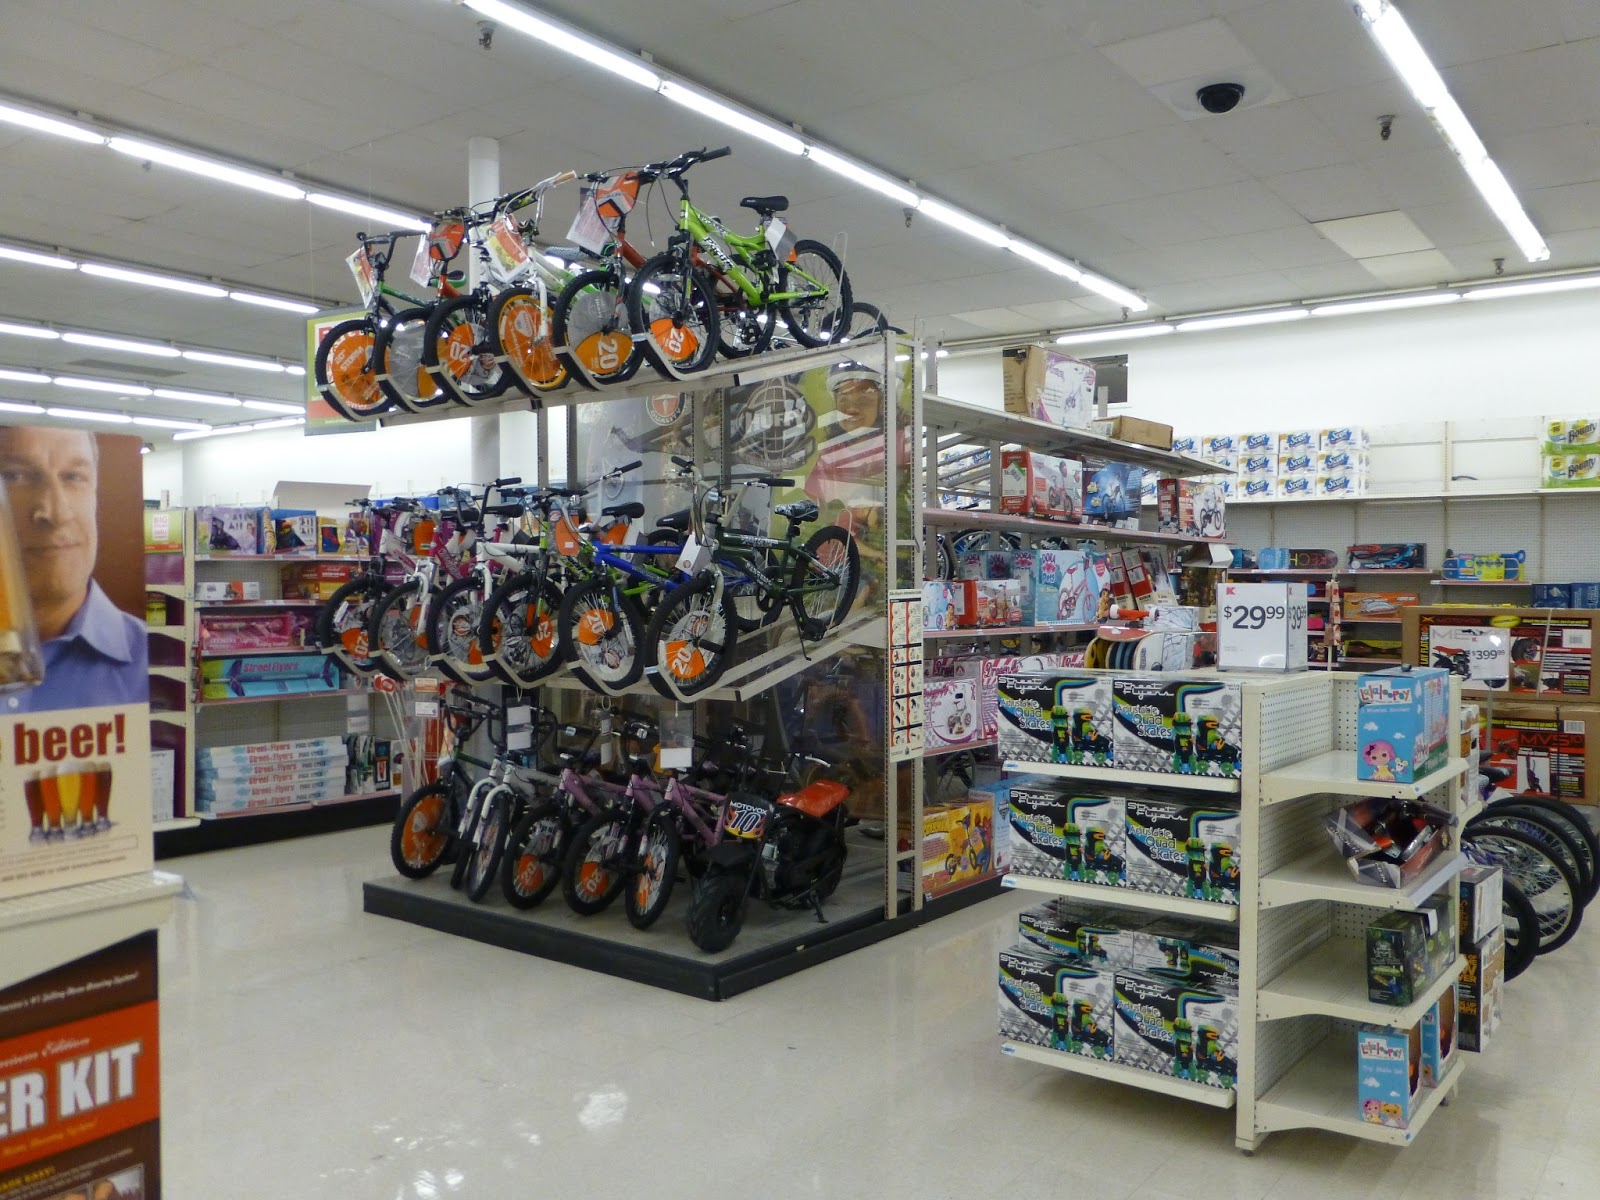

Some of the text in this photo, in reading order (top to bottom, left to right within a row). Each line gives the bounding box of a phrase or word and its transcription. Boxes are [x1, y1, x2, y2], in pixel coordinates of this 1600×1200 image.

[668, 329, 684, 353] 20
[450, 341, 471, 361] 20
[598, 339, 618, 369] 20
[650, 407, 681, 423] QUALITY
[1568, 422, 1597, 443] Bounty
[1568, 458, 1596, 478] Bounty
[587, 612, 604, 634] 20
[672, 647, 691, 675] 20
[998, 677, 1042, 685] Street
[1114, 681, 1162, 690] Street
[1006, 684, 1053, 694] Flyers
[1123, 687, 1174, 700] Flyers
[1014, 708, 1043, 718] Quad
[1132, 714, 1163, 725] Quad
[1019, 718, 1050, 729] Skates
[1137, 724, 1172, 738] Skates
[14, 713, 125, 765] beer!
[1010, 790, 1055, 800] Street
[730, 800, 768, 815] MOTOVOX
[1018, 798, 1065, 809] Flyers
[1127, 802, 1176, 814] Street
[729, 810, 761, 833] 10
[1136, 810, 1188, 822] Flyers
[1026, 822, 1054, 834] Quad
[1031, 832, 1063, 846] Skates
[1145, 836, 1176, 849] Quad
[1150, 847, 1185, 863] Skates
[1000, 955, 1043, 968] Street
[1008, 963, 1053, 977] Flyers
[1116, 976, 1164, 991] Street
[1015, 988, 1043, 1001] Quad
[1125, 985, 1175, 1000] Flyers
[1020, 998, 1051, 1014] Skates
[1133, 1011, 1165, 1028] Quad
[1138, 1023, 1174, 1041] Skates
[58, 1042, 141, 1118] KIT
